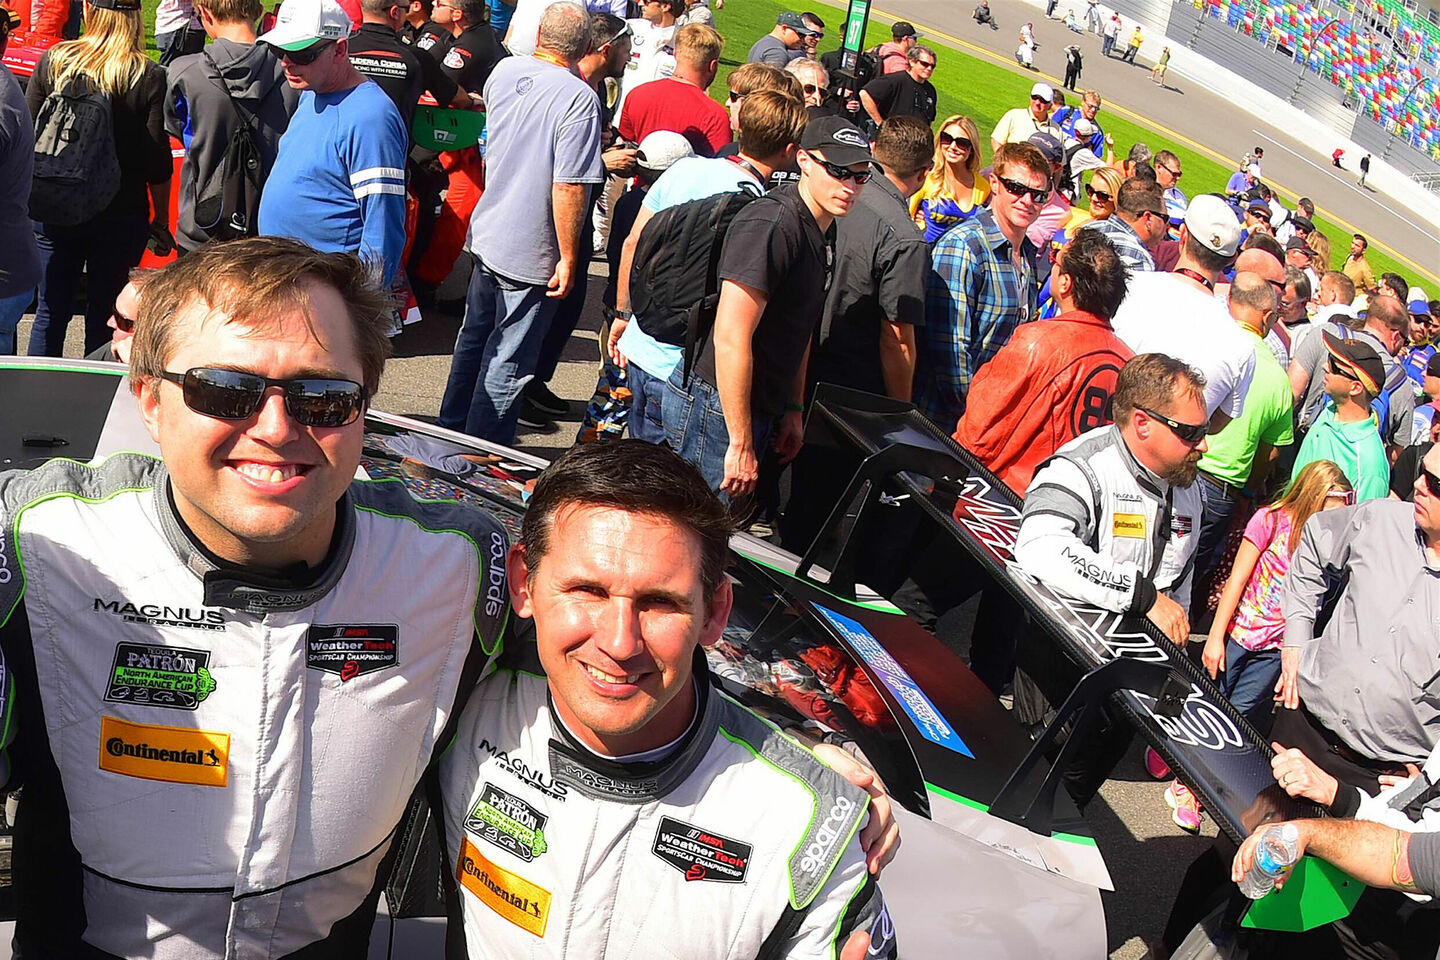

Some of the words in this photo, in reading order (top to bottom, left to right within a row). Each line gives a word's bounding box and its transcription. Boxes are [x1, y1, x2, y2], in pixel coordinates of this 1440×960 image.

[485, 531, 506, 620] sparco
[1061, 547, 1131, 588] MAGNUS
[94, 599, 226, 625] MAGNUS
[958, 476, 1244, 750] MANUS
[128, 653, 196, 673] PATRÓN
[310, 641, 394, 651] WeatherTech
[106, 737, 204, 765] Continental
[479, 740, 569, 796] MAGNUS
[566, 765, 658, 790] MAGNUS
[490, 792, 538, 829] PATRÓN
[661, 832, 744, 867] WeatherTech
[801, 796, 856, 878] sparco
[463, 857, 528, 911] Continental
